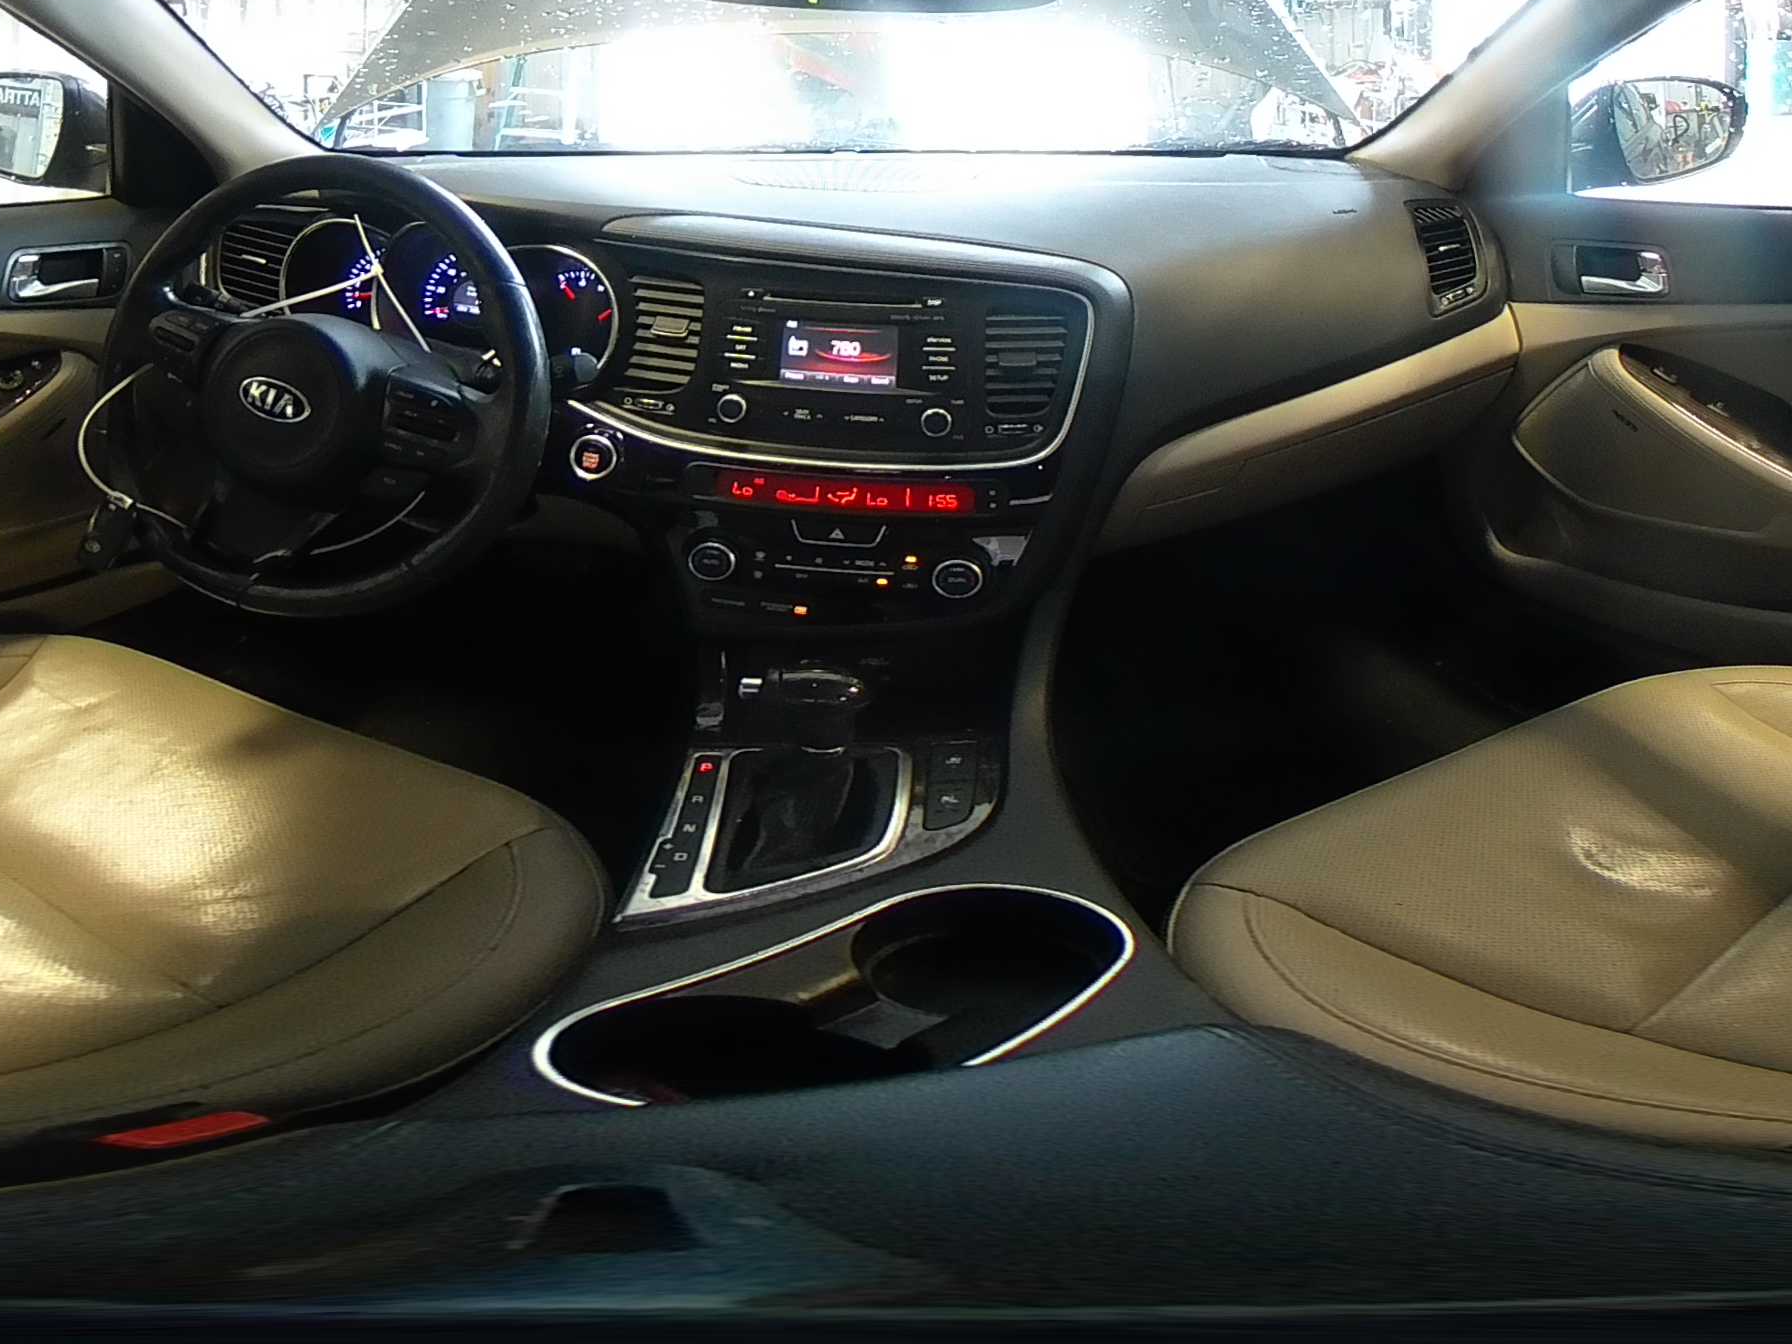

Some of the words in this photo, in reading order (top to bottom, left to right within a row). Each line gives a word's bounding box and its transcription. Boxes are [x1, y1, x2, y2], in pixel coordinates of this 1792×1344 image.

[830, 340, 861, 357] 780
[246, 381, 294, 419] KIA
[699, 762, 714, 773] P
[690, 795, 705, 804] R
[682, 823, 697, 833] N
[673, 851, 688, 862] D
